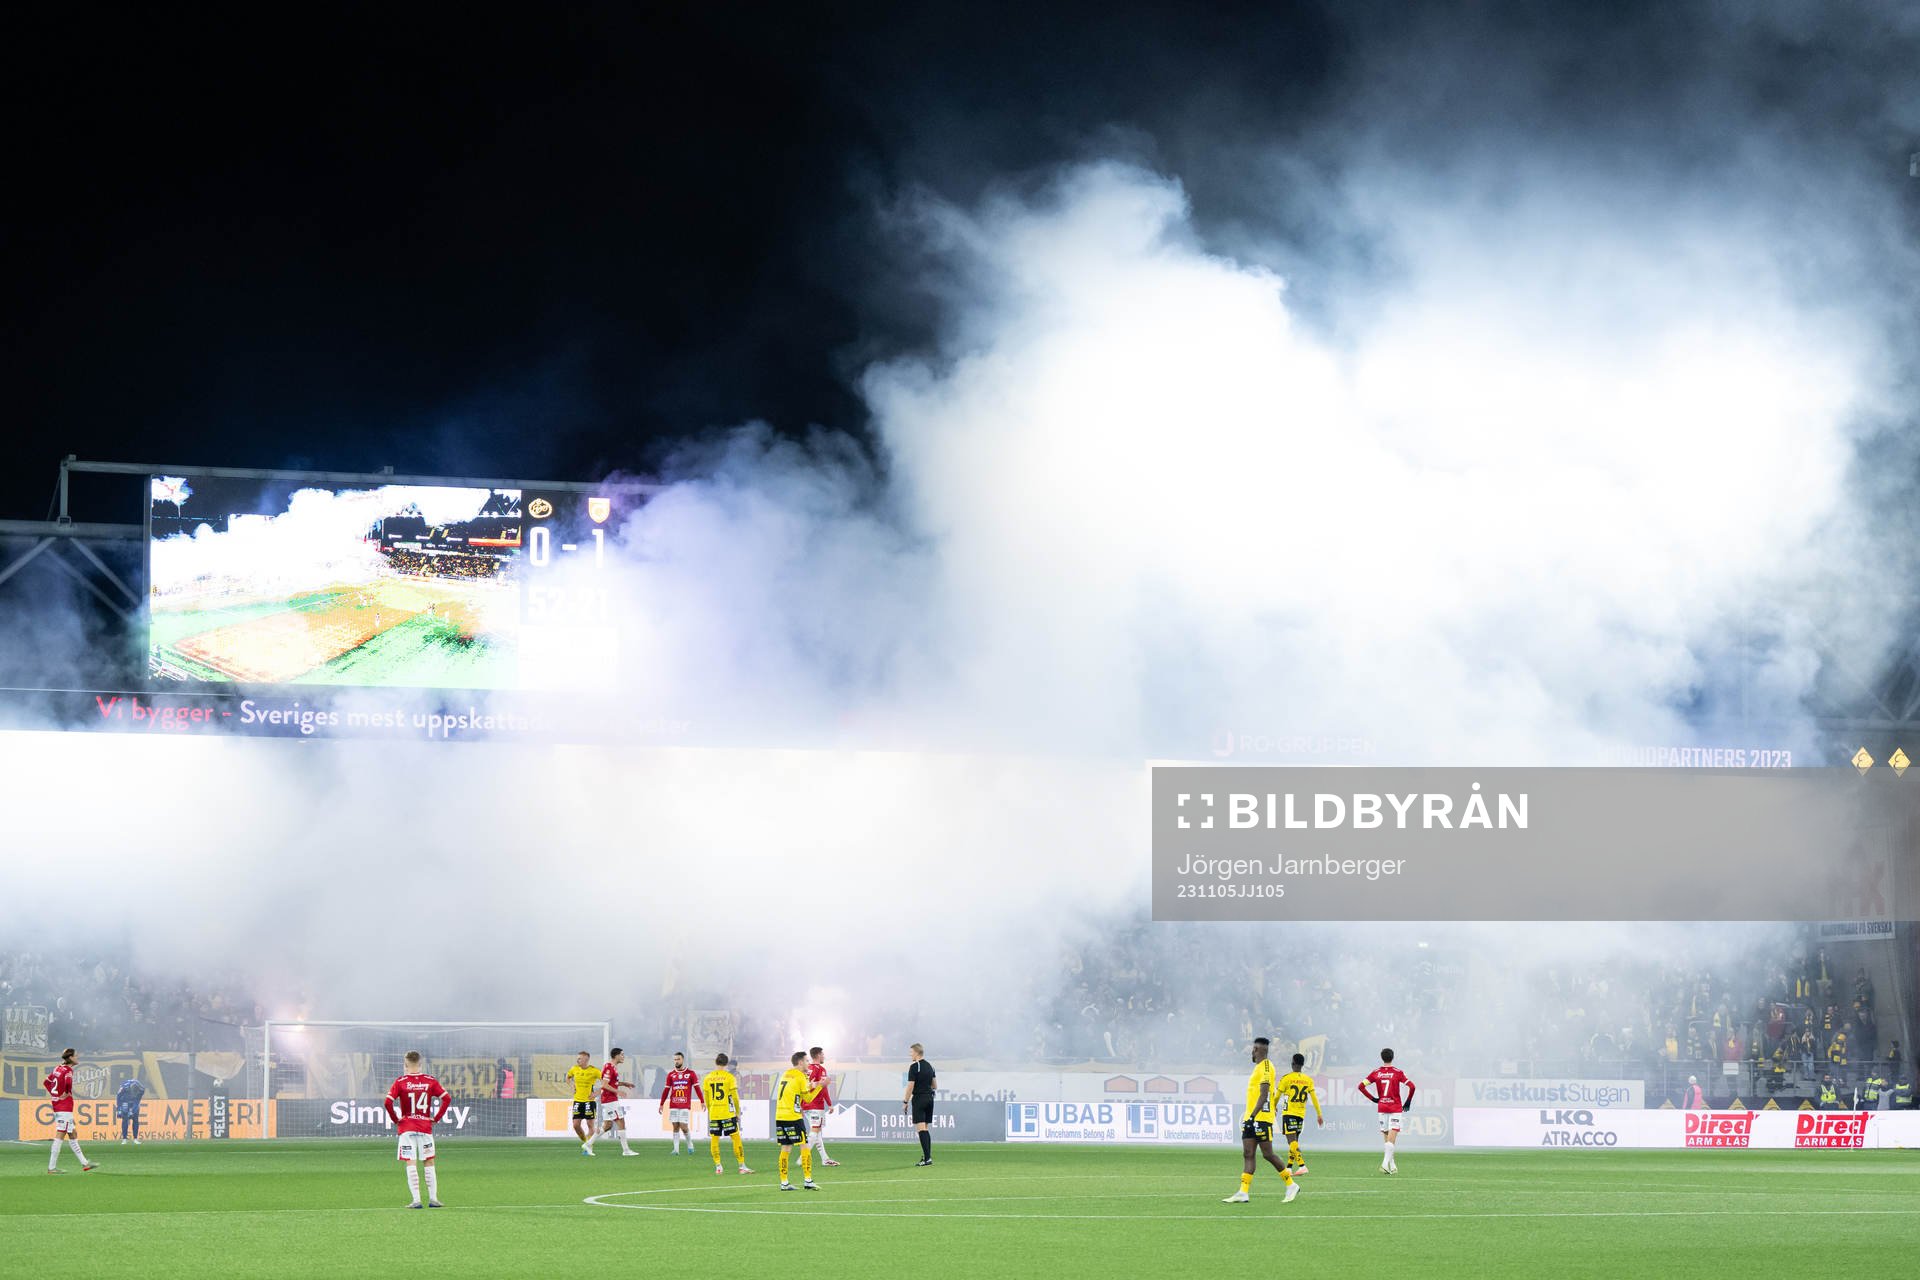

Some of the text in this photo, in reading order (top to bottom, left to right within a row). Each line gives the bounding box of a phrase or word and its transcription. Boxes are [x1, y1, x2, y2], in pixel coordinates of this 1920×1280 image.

[97, 695, 123, 720] Vi
[132, 698, 214, 731] bygger
[240, 700, 338, 734] Sveriges
[347, 706, 406, 728] mest
[1750, 749, 1792, 768] 2023
[51, 1078, 58, 1095] 2
[709, 1082, 725, 1101] 15
[779, 1080, 788, 1100] 7
[1290, 1084, 1309, 1103] 26
[1381, 1079, 1390, 1097] 7
[1472, 1081, 1630, 1107] VästkustStugan
[408, 1091, 429, 1114] 14
[35, 1103, 149, 1126] GSEE
[213, 1095, 226, 1138] SELECT
[881, 1114, 956, 1129] BORGENA
[1045, 1103, 1113, 1124] UBAB
[1164, 1105, 1231, 1126] UBAB
[1540, 1110, 1594, 1125] LKQ
[1686, 1111, 1754, 1134] Direct
[1797, 1112, 1869, 1134] Direct
[1106, 1129, 1115, 1139] AB
[1224, 1130, 1232, 1140] AB
[1542, 1131, 1617, 1146] ATRACCO
[1716, 1137, 1722, 1145] &
[1797, 1138, 1828, 1146] LARM
[1831, 1138, 1837, 1146] &
